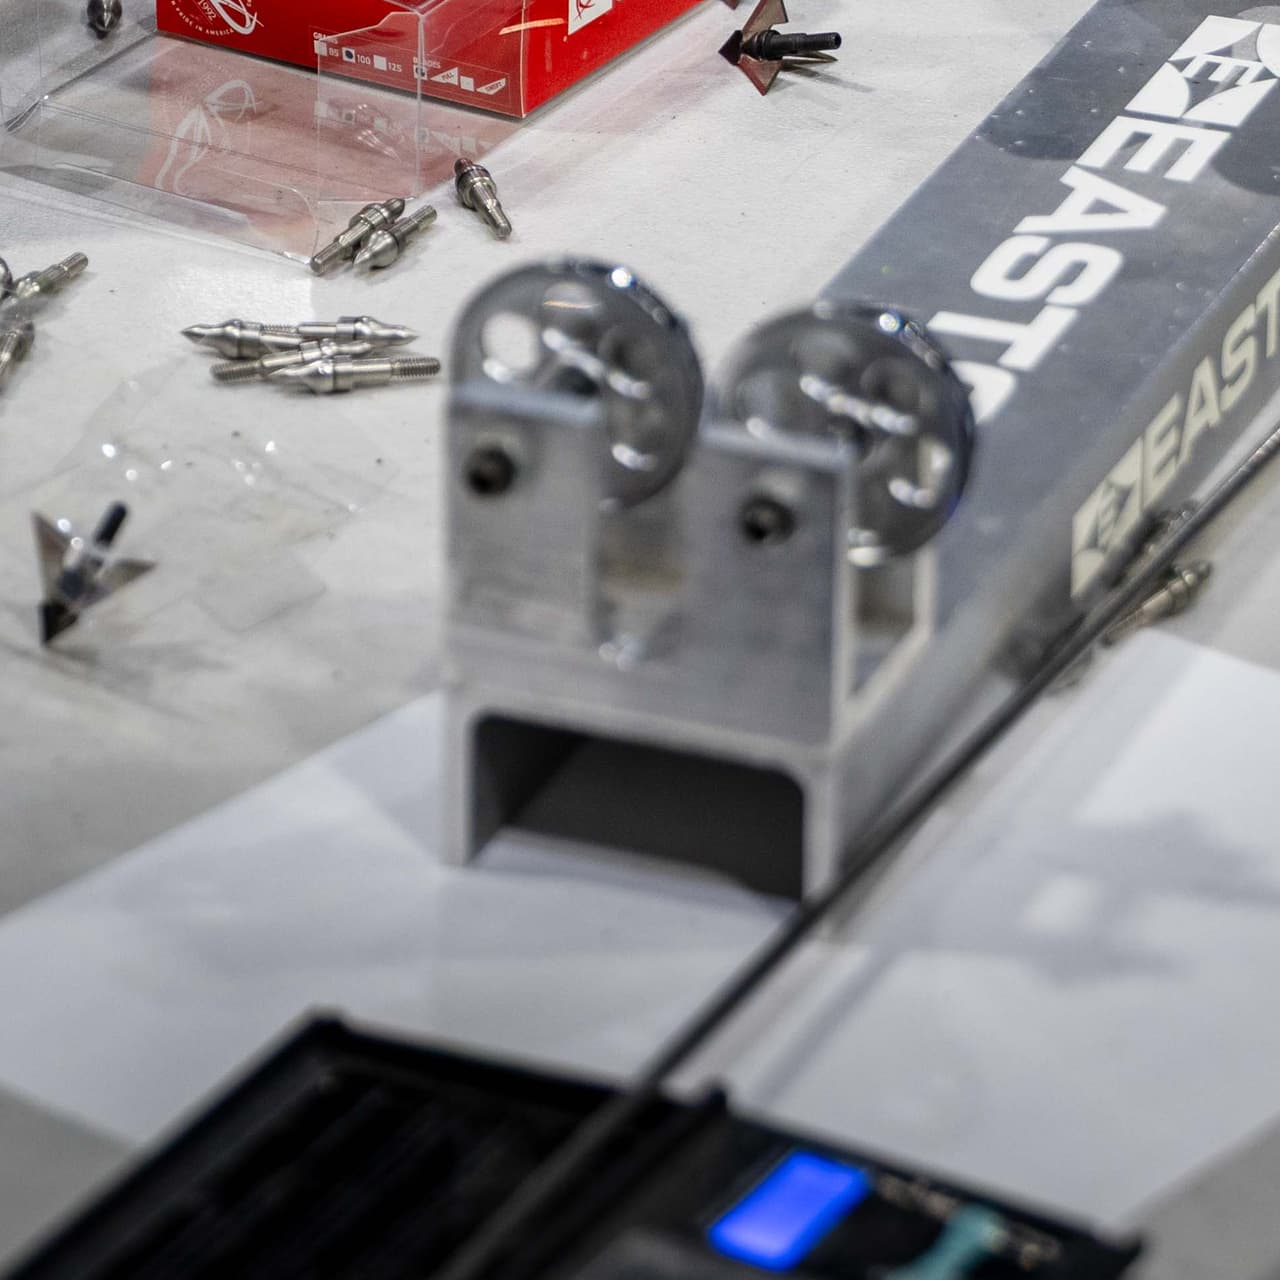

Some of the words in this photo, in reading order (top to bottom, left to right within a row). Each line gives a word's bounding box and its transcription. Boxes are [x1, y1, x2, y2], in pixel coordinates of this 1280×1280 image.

[177, 4, 195, 28] PRIDE
[205, 28, 234, 37] AMERICA
[356, 54, 371, 65] 100
[387, 61, 402, 72] 125
[925, 116, 1230, 424] EAST
